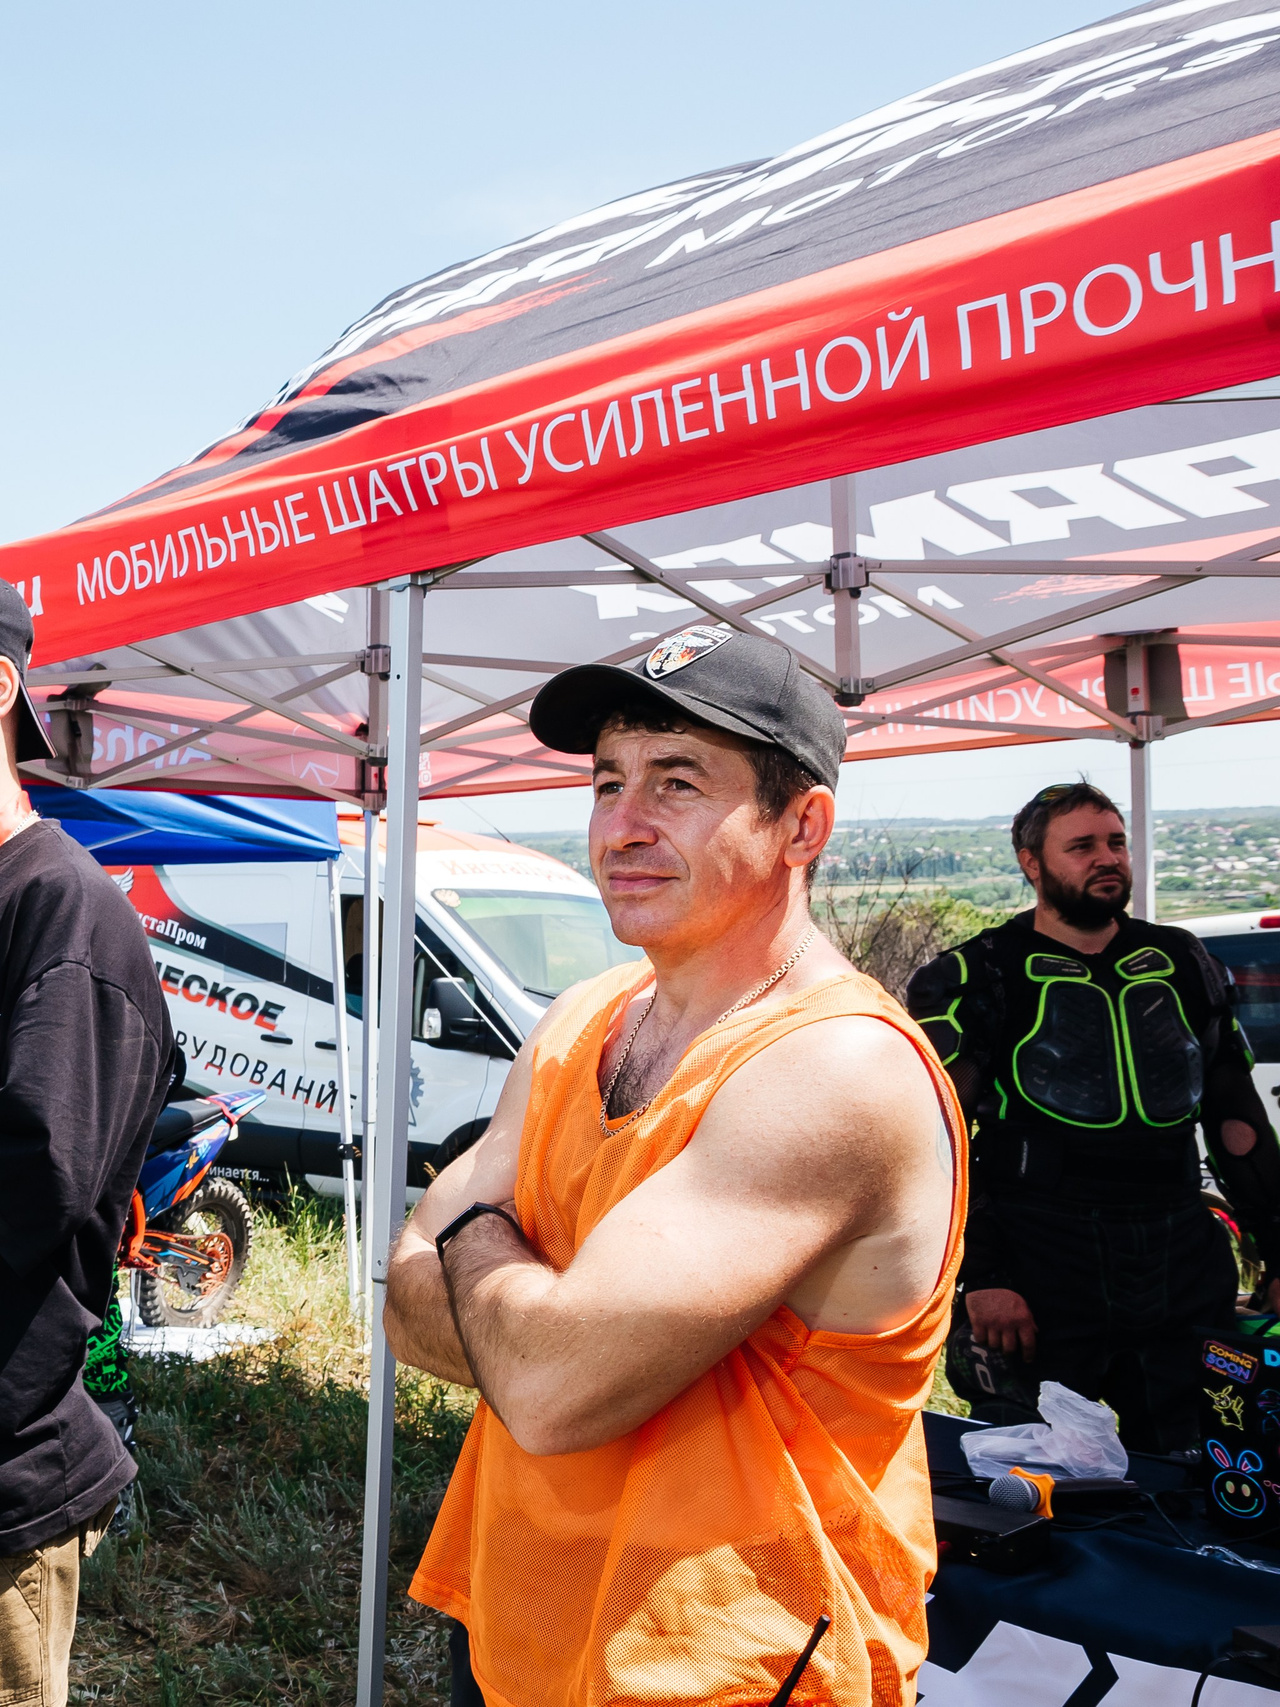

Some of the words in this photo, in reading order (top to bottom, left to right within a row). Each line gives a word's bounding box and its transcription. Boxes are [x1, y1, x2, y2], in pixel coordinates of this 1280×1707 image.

[644, 43, 1265, 270] MOTORS
[76, 491, 316, 606] МОБИЛЬНЫЕ
[317, 437, 499, 536] ШАТРЫ
[504, 305, 930, 486] УСИЛЕННОЙ
[957, 220, 1280, 371] ПРОЧН
[138, 912, 207, 950] стаПром
[156, 962, 286, 1032] ЕСКОЕ
[176, 1030, 357, 1114] РУДОВАНИ
[207, 1166, 269, 1182] инается...
[1206, 1353, 1250, 1380] SOON
[1209, 1345, 1252, 1369] COMING
